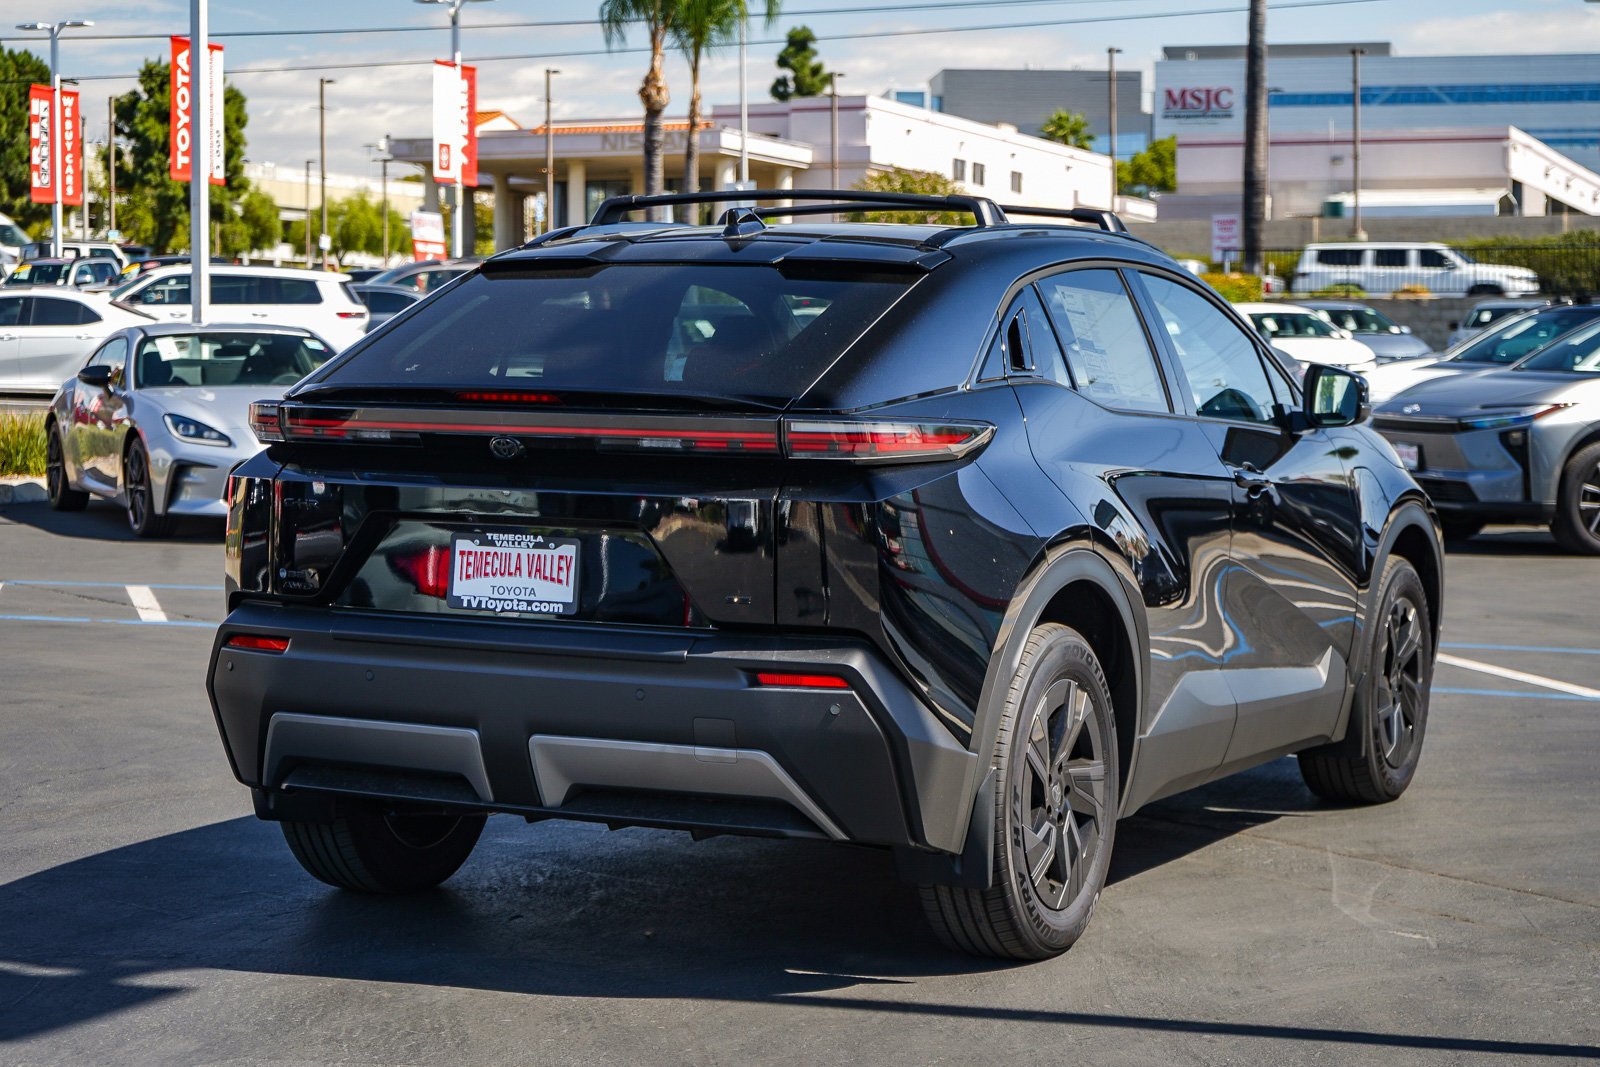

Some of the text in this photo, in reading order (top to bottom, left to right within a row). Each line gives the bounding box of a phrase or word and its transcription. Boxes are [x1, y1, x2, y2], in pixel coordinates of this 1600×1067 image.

[62, 96, 75, 118] WE
[177, 49, 190, 170] TOYOTA
[1164, 86, 1234, 112] MSJC
[65, 153, 75, 196] CARS
[486, 533, 544, 543] TEMECULA
[495, 540, 535, 549] VALLEY
[459, 550, 573, 588] TEMECULA VALLEY
[490, 585, 537, 597] TOYOTA
[461, 595, 563, 613] TVToyota.com
